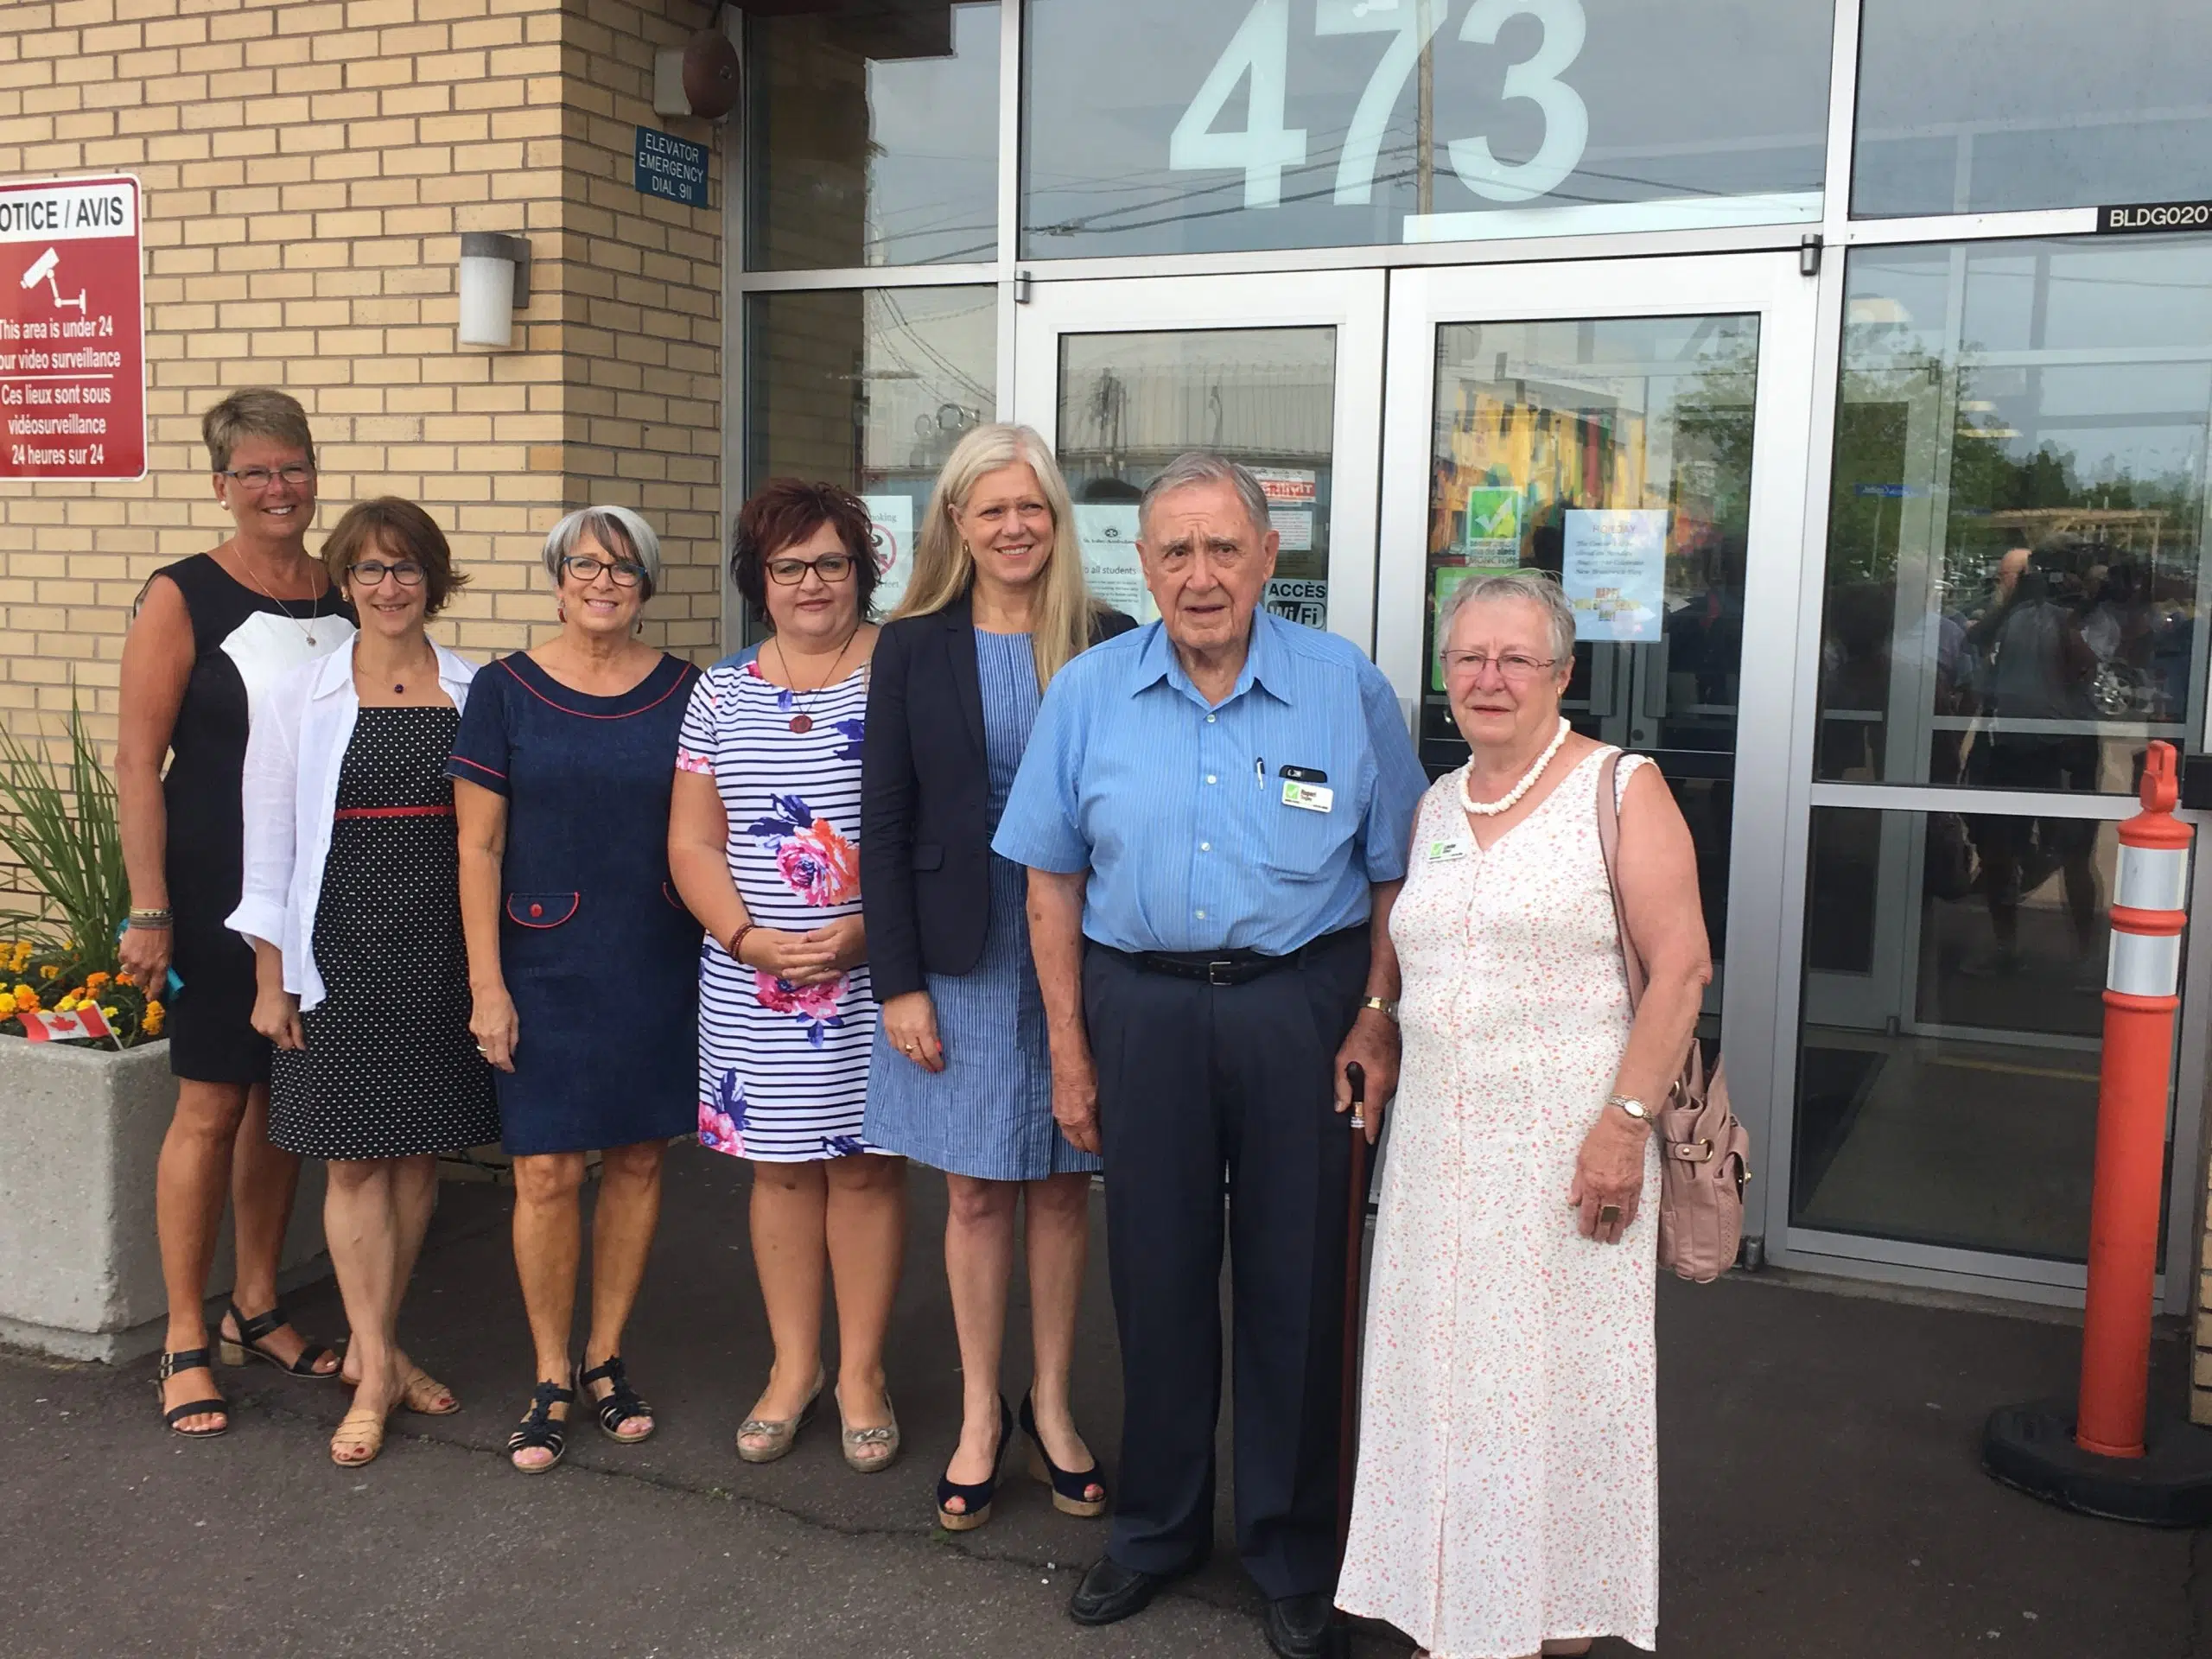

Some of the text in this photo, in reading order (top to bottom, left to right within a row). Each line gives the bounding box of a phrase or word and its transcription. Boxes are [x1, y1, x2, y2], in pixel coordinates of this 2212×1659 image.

[1169, 0, 1589, 209] 473
[645, 133, 699, 163] ELEVATOR
[639, 151, 704, 184] EMERGENCY
[652, 175, 692, 200] DIAL 911
[0, 200, 59, 232] OTICE
[76, 196, 124, 228] AVIS
[2110, 206, 2212, 227] BLDG020
[0, 315, 113, 340] This area is under 24
[18, 347, 49, 369] video
[52, 346, 121, 369] surveillance
[2, 385, 111, 405] Ces lieux sont sous
[8, 414, 106, 435] vidéosurveillance
[11, 443, 105, 466] 24 heures sur 24
[1091, 565, 1101, 574] all
[1103, 565, 1137, 575] students
[1268, 582, 1326, 598] ACCÈS
